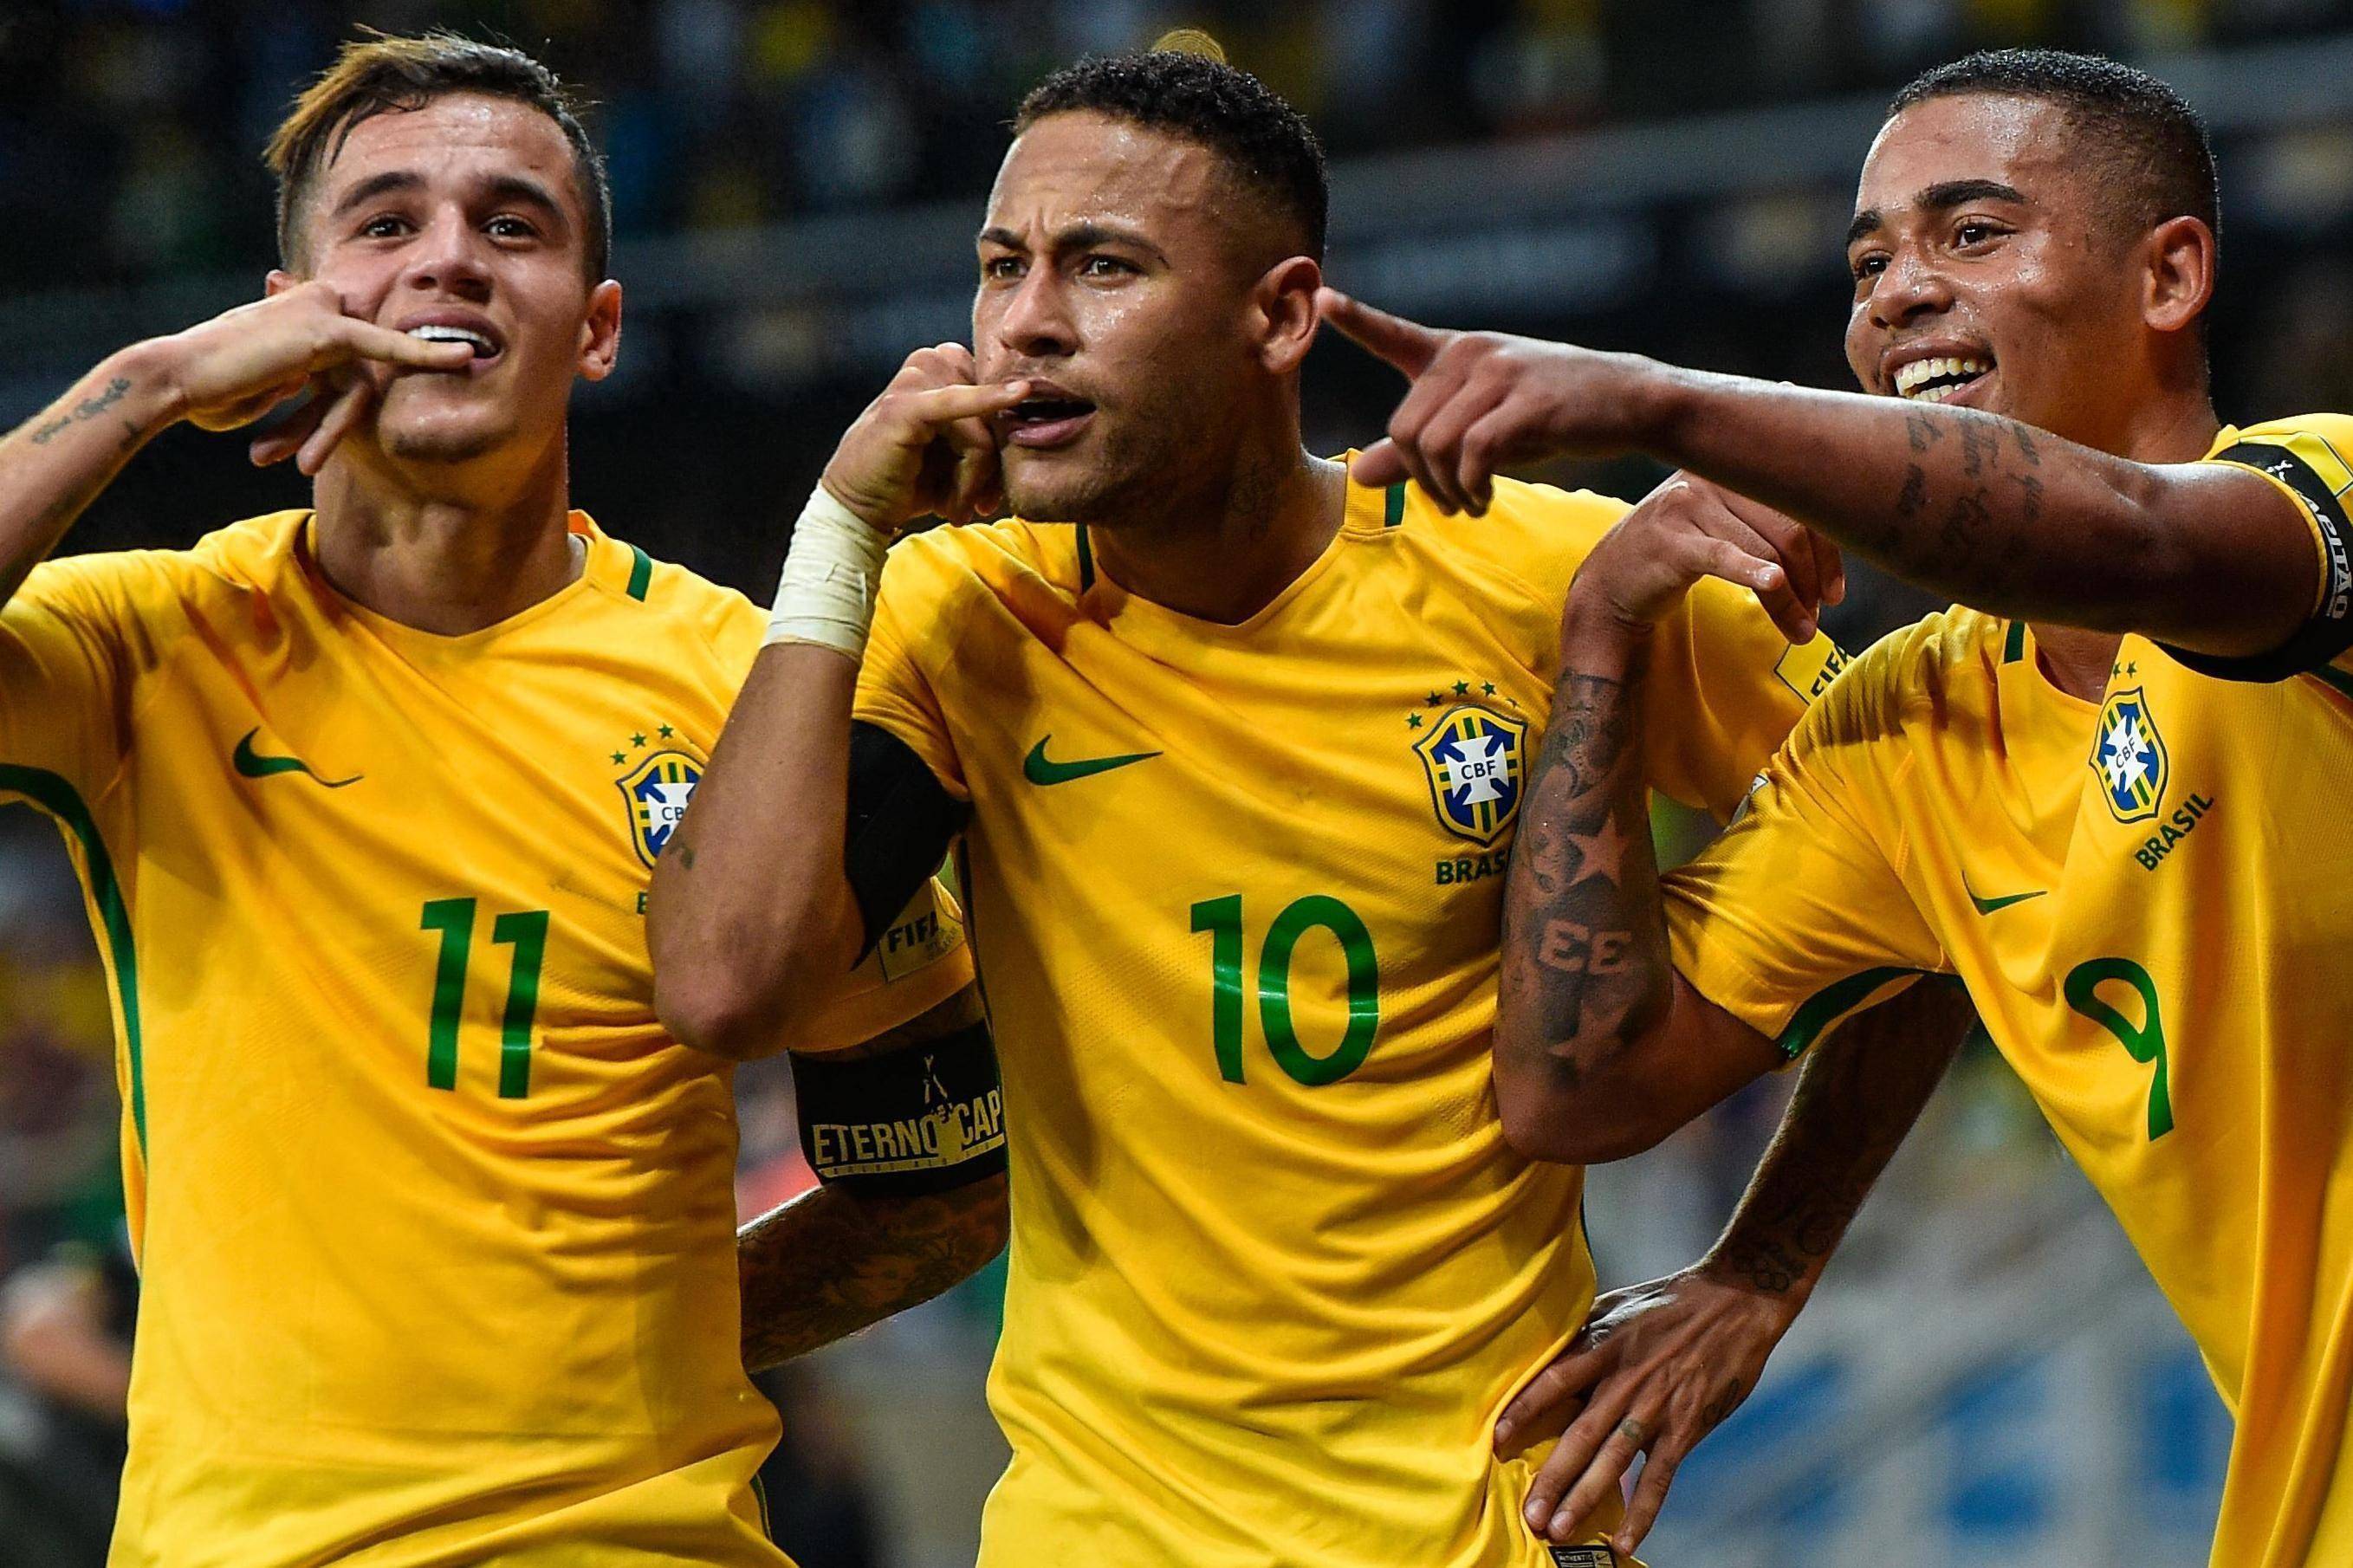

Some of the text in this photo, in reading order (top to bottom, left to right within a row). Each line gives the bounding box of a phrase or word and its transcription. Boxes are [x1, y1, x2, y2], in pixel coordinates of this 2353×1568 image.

[1461, 760, 1496, 780] CBF
[2116, 737, 2136, 769] CBF
[2135, 793, 2214, 871] BRASIL
[423, 899, 548, 1097] 11
[1192, 895, 1378, 1085] 10
[2066, 961, 2172, 1140] 9
[812, 1115, 938, 1166] ETERNO
